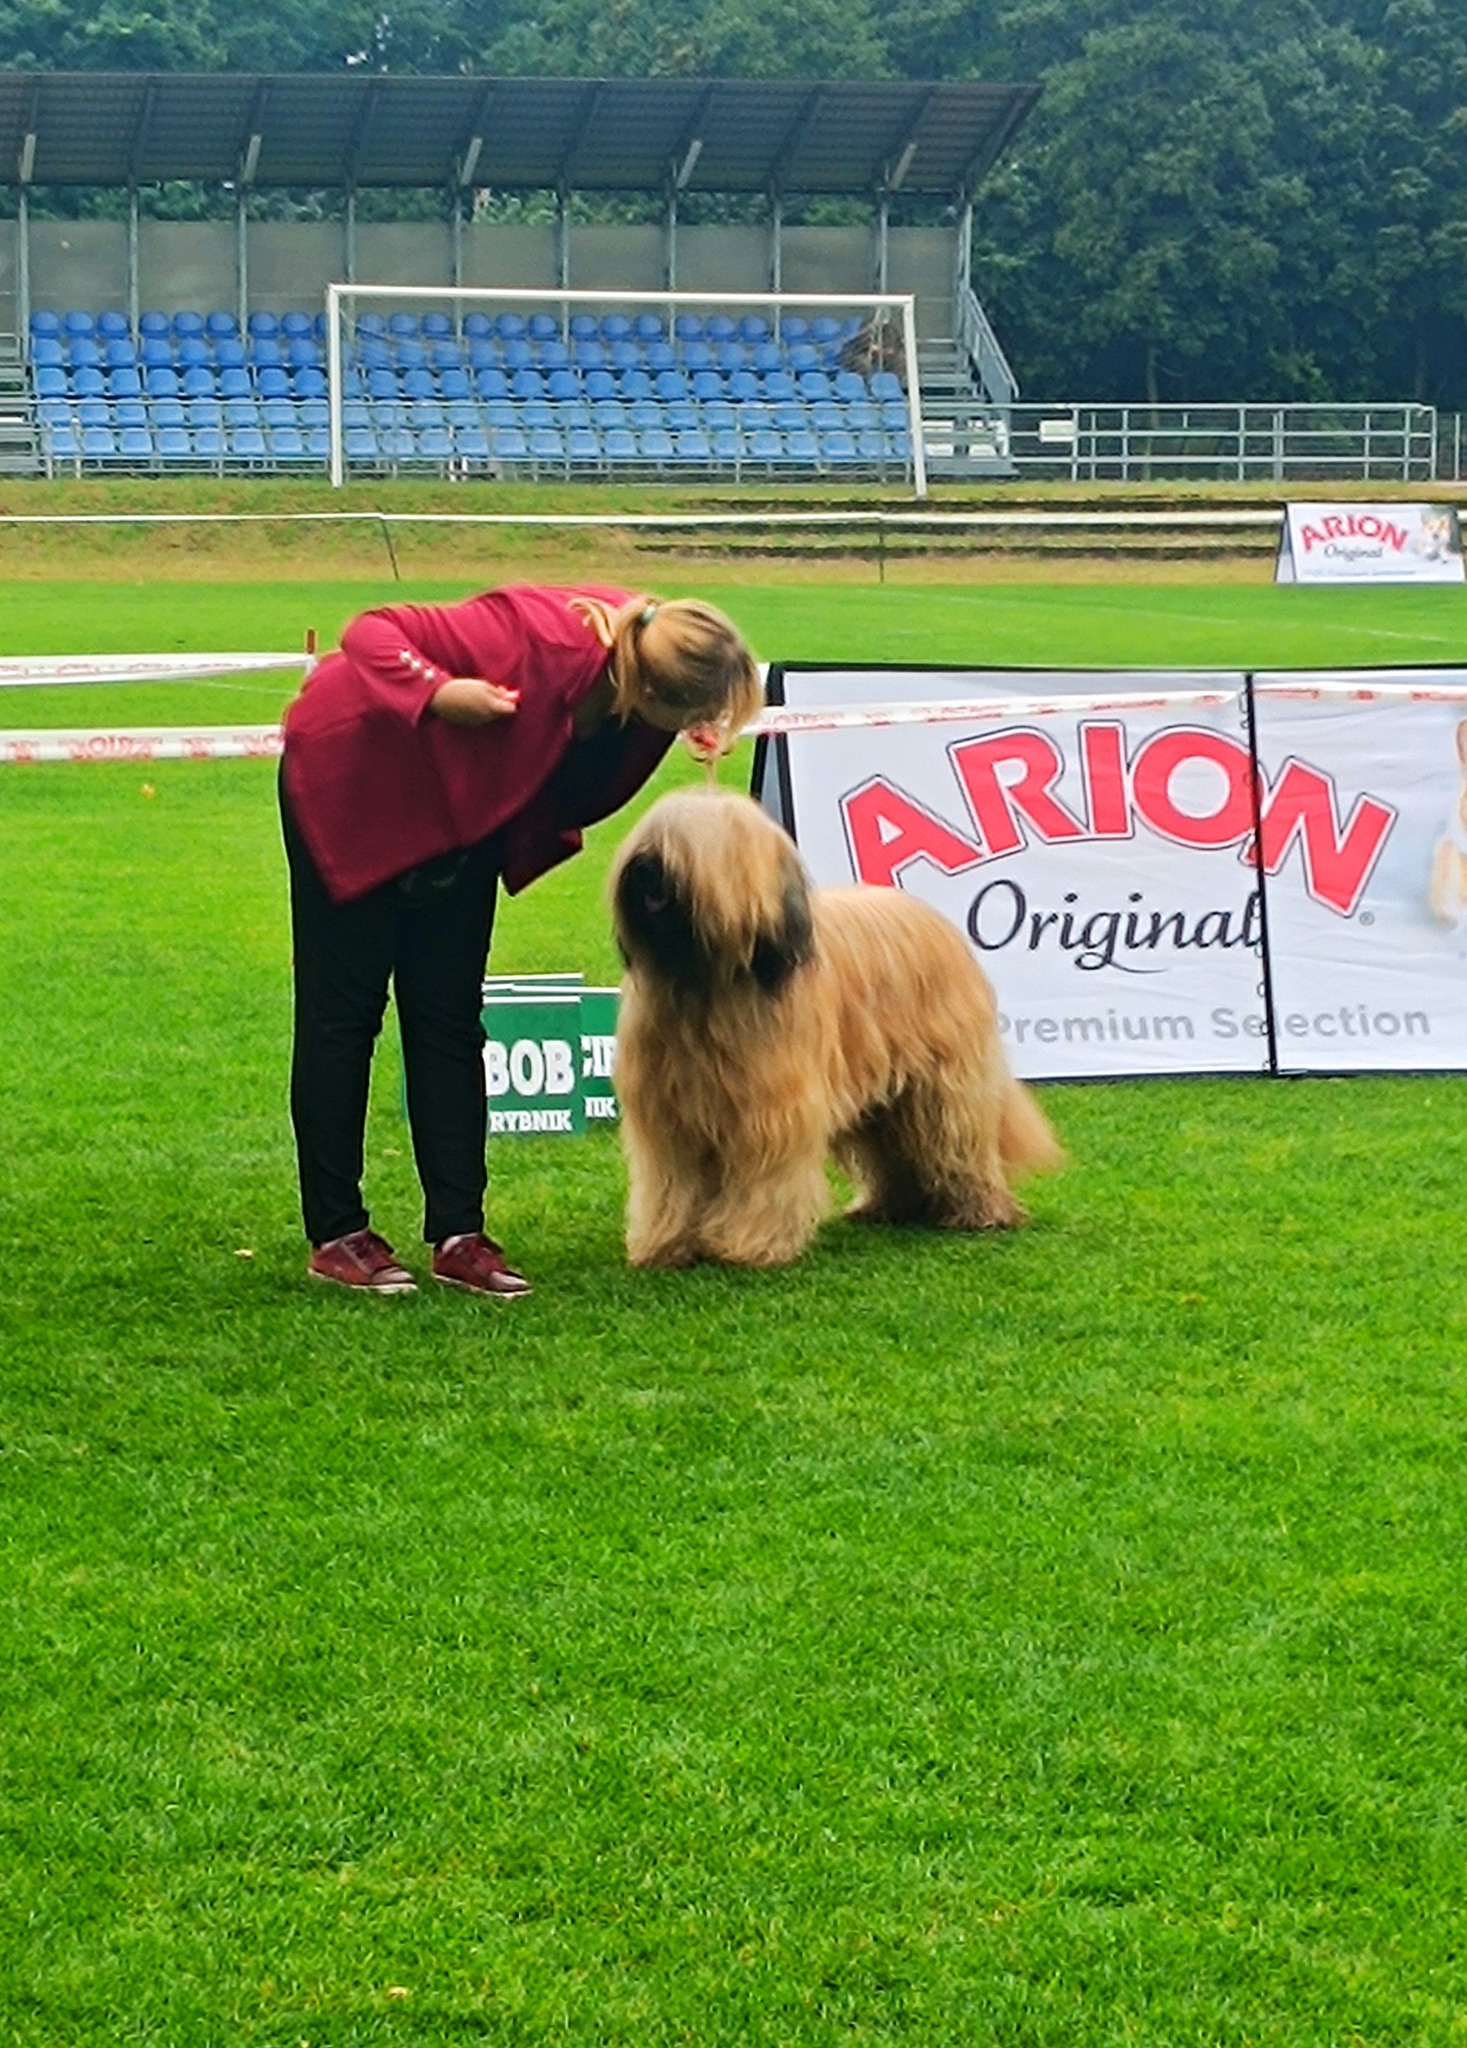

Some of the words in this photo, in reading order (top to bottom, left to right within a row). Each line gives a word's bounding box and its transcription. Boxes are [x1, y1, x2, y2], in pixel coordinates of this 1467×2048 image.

[1301, 514, 1409, 553] ARION
[838, 719, 1397, 917] ARION
[966, 878, 1266, 974] Original
[482, 1038, 575, 1096] BOB
[489, 1110, 573, 1133] RYBNIK
